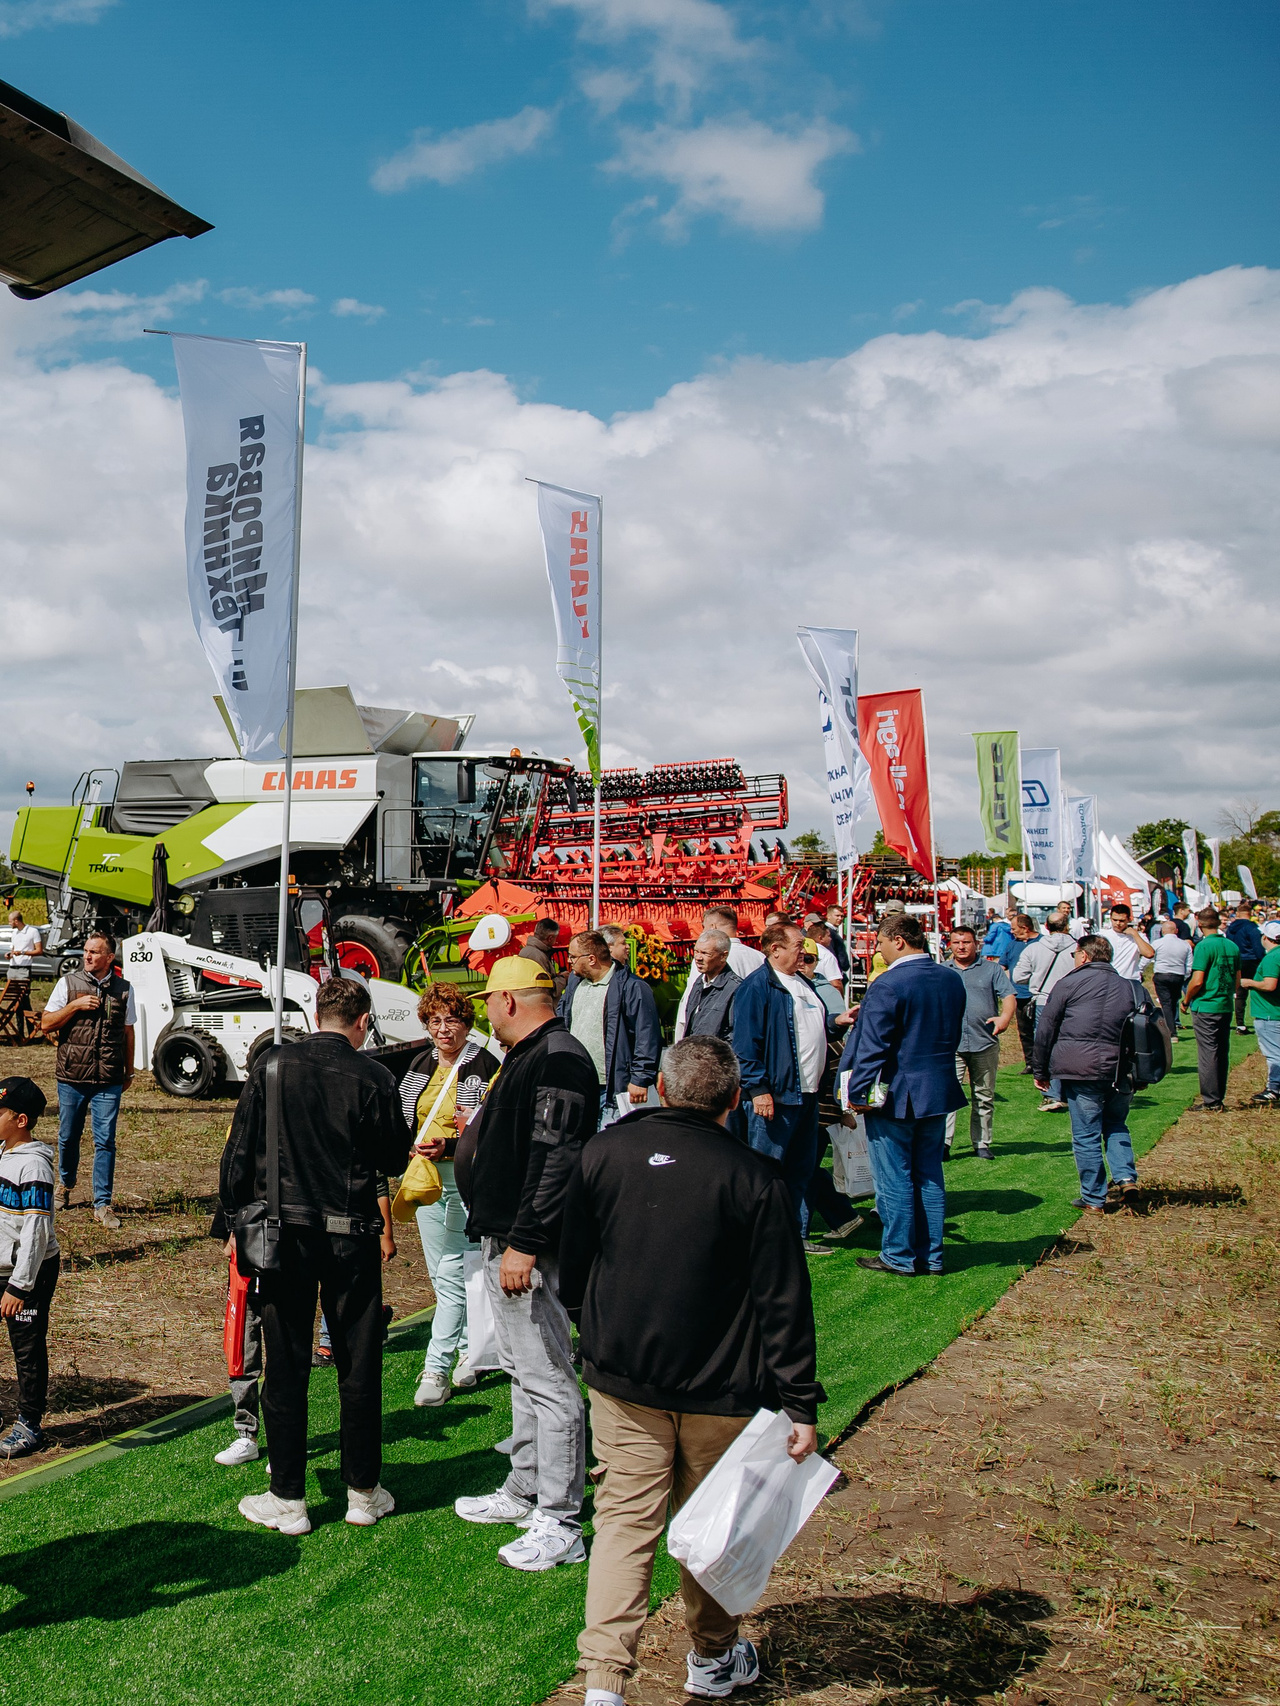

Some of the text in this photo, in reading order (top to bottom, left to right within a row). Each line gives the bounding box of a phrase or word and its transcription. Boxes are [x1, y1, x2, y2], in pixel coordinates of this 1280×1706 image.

[89, 864, 124, 873] TRION
[130, 951, 153, 963] 830
[388, 1008, 411, 1017] 930
[376, 1013, 405, 1022] AXFLEX
[653, 1153, 670, 1161] NIKE
